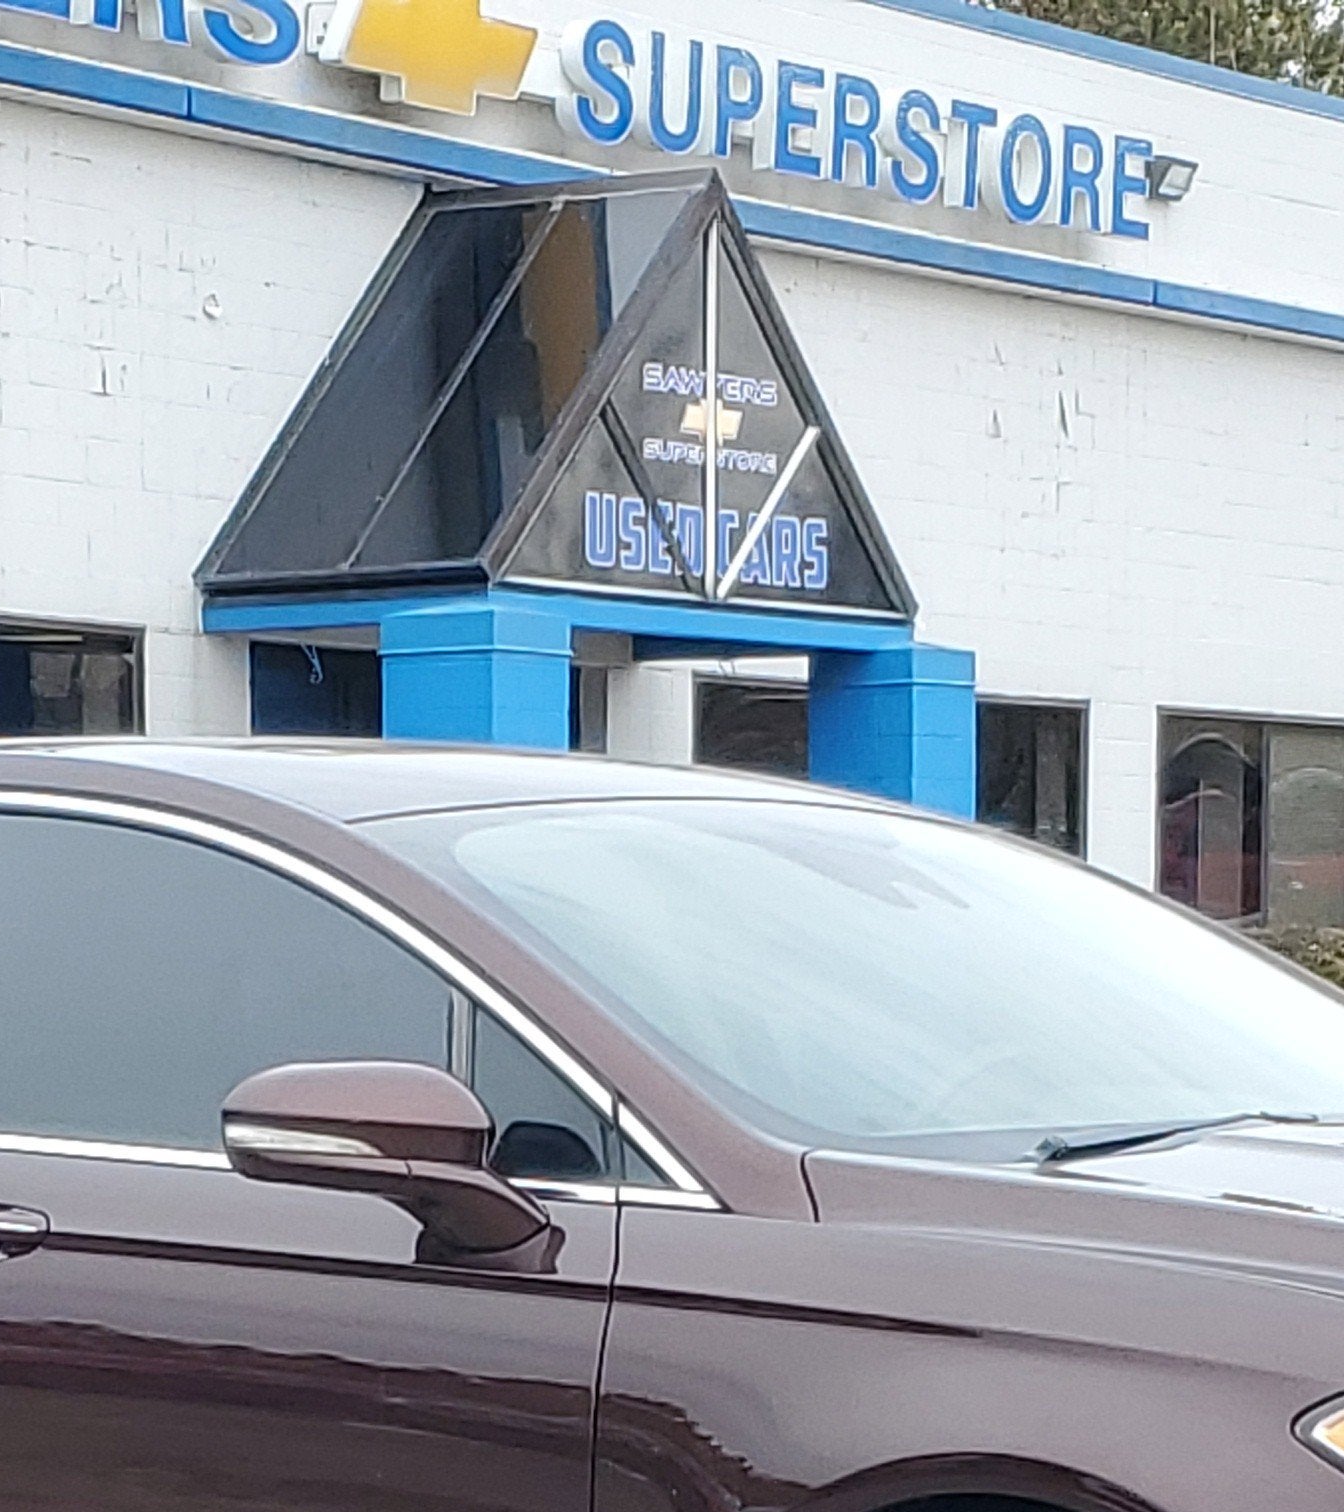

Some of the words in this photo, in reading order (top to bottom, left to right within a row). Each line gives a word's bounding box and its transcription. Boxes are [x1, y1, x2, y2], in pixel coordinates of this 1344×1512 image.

[575, 19, 1154, 240] SUPERSTORE
[584, 491, 704, 577] USED
[716, 509, 828, 589] CARS
